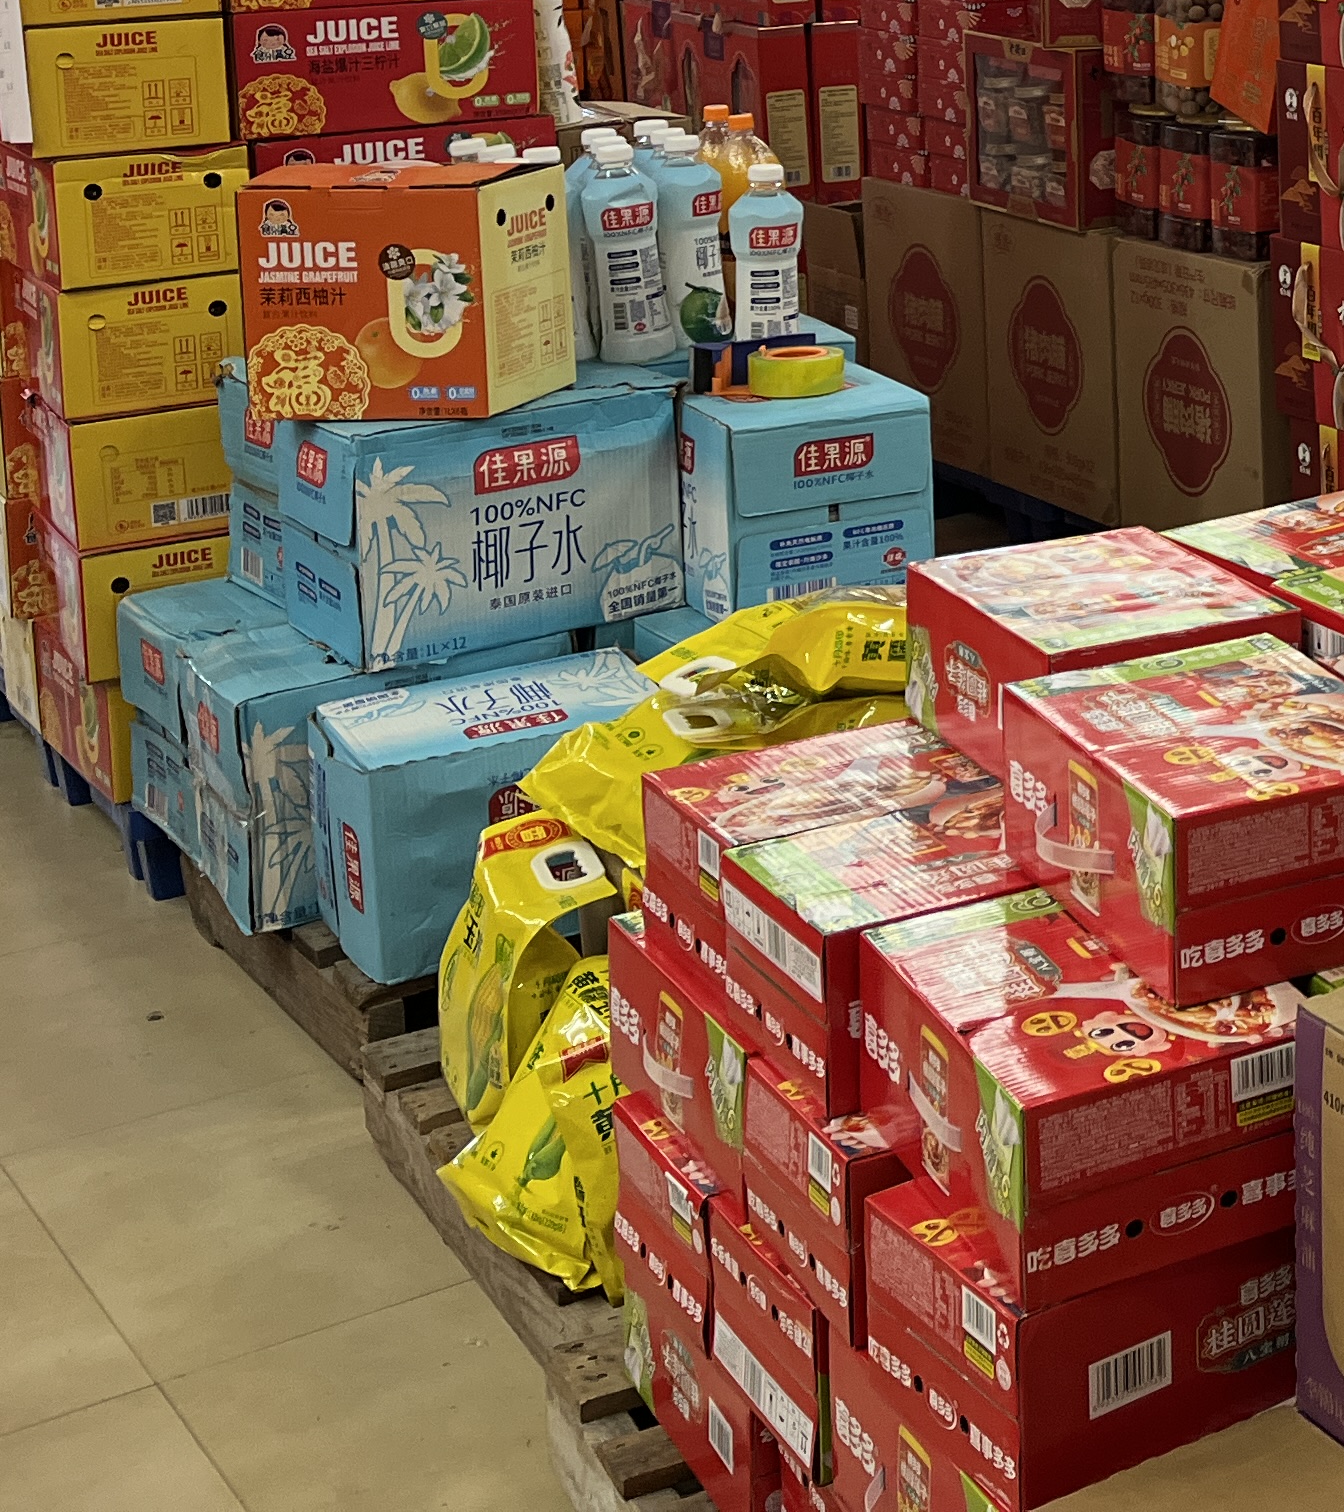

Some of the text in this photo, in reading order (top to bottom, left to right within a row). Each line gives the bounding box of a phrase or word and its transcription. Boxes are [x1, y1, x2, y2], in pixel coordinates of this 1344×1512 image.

[95, 30, 158, 48] JUICE
[306, 16, 399, 43] JUICE
[334, 137, 426, 165] JUICE
[122, 161, 184, 179] JUICE
[506, 207, 547, 238] JUICE
[602, 203, 653, 230] 佳果源
[750, 224, 798, 248] 佳果源
[258, 241, 358, 269] JUICE
[258, 270, 358, 284] JASMINE GRAPEFRUIT
[127, 287, 189, 307] JUICE
[259, 287, 347, 307] 茉莉西柚汁
[479, 439, 577, 490] 佳果源
[797, 437, 868, 473] 佳果源
[469, 488, 587, 527] 100%NFC
[152, 546, 213, 570] JUICE
[471, 514, 587, 593] 椰子水
[489, 583, 574, 611] 泰国原装进口
[607, 585, 680, 614] 全国销量第一
[435, 680, 553, 717] 椰子水
[449, 698, 562, 727] 100%NFC
[471, 711, 564, 737] 佳果源
[1180, 928, 1265, 969] 吃喜多多
[1027, 1195, 1208, 1274] 吃喜多多 喜多多
